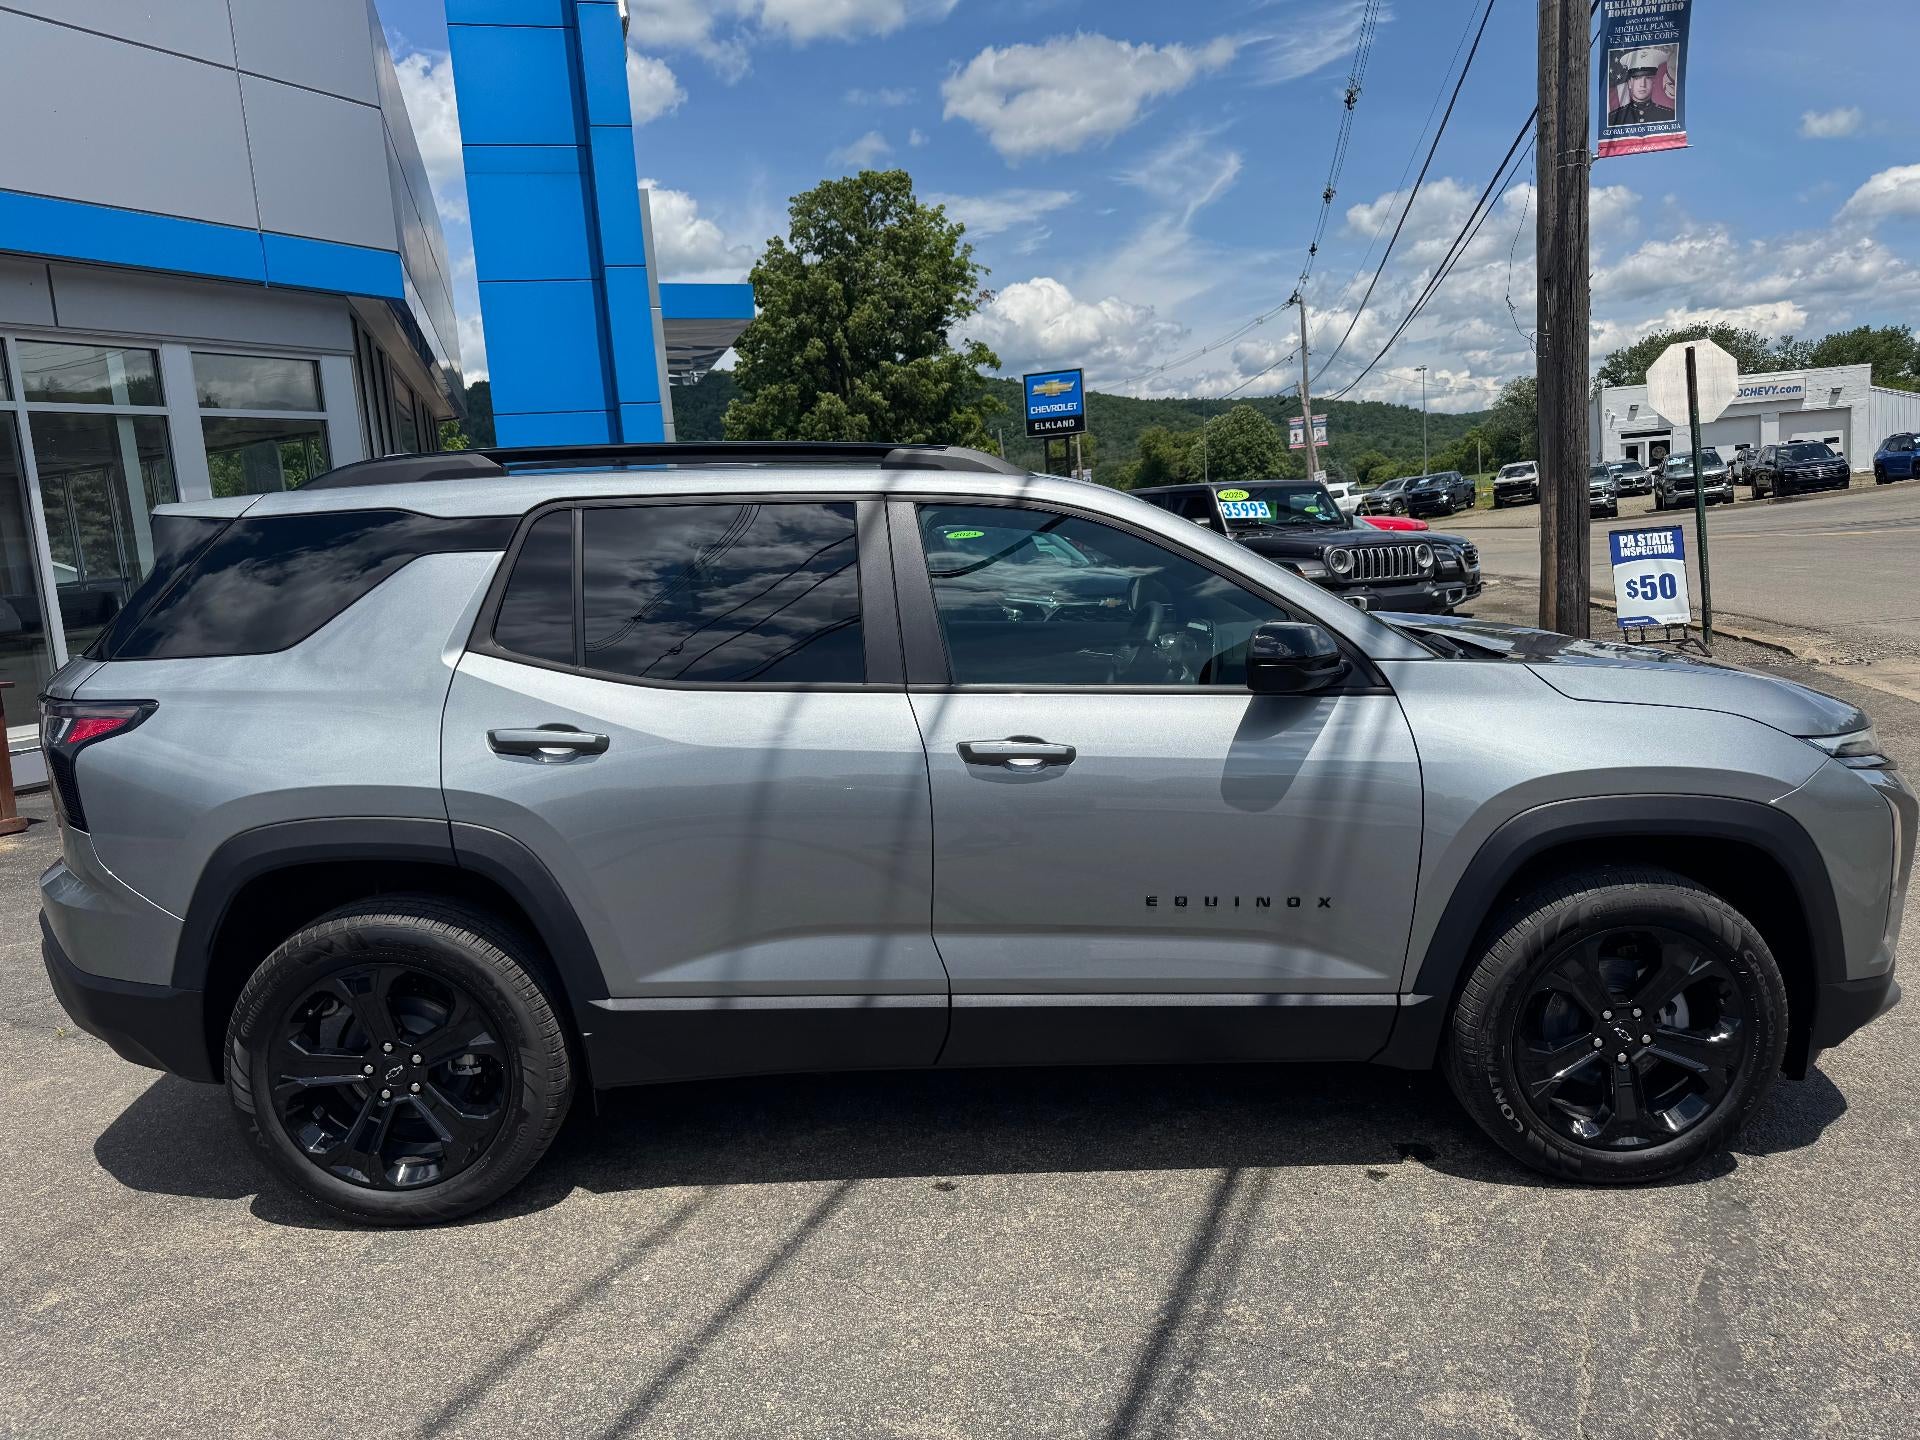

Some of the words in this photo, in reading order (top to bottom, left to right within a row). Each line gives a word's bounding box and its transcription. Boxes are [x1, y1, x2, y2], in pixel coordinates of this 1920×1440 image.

[1608, 5, 1657, 17] HOMETOWN
[1660, 2, 1684, 12] HERO
[1614, 24, 1648, 33] MICHAEL
[1624, 34, 1653, 43] MARINE
[1654, 31, 1680, 40] CORPS
[1031, 402, 1077, 414] CHEVROLET
[1034, 419, 1075, 430] ELKLAND
[1223, 491, 1244, 499] 2025
[1222, 502, 1268, 517] 35995
[1619, 534, 1635, 547] PA
[1636, 531, 1673, 546] STATE
[1620, 544, 1675, 557] INSPECTION
[1625, 573, 1677, 601] $50
[1145, 895, 1332, 909] EQUINOX
